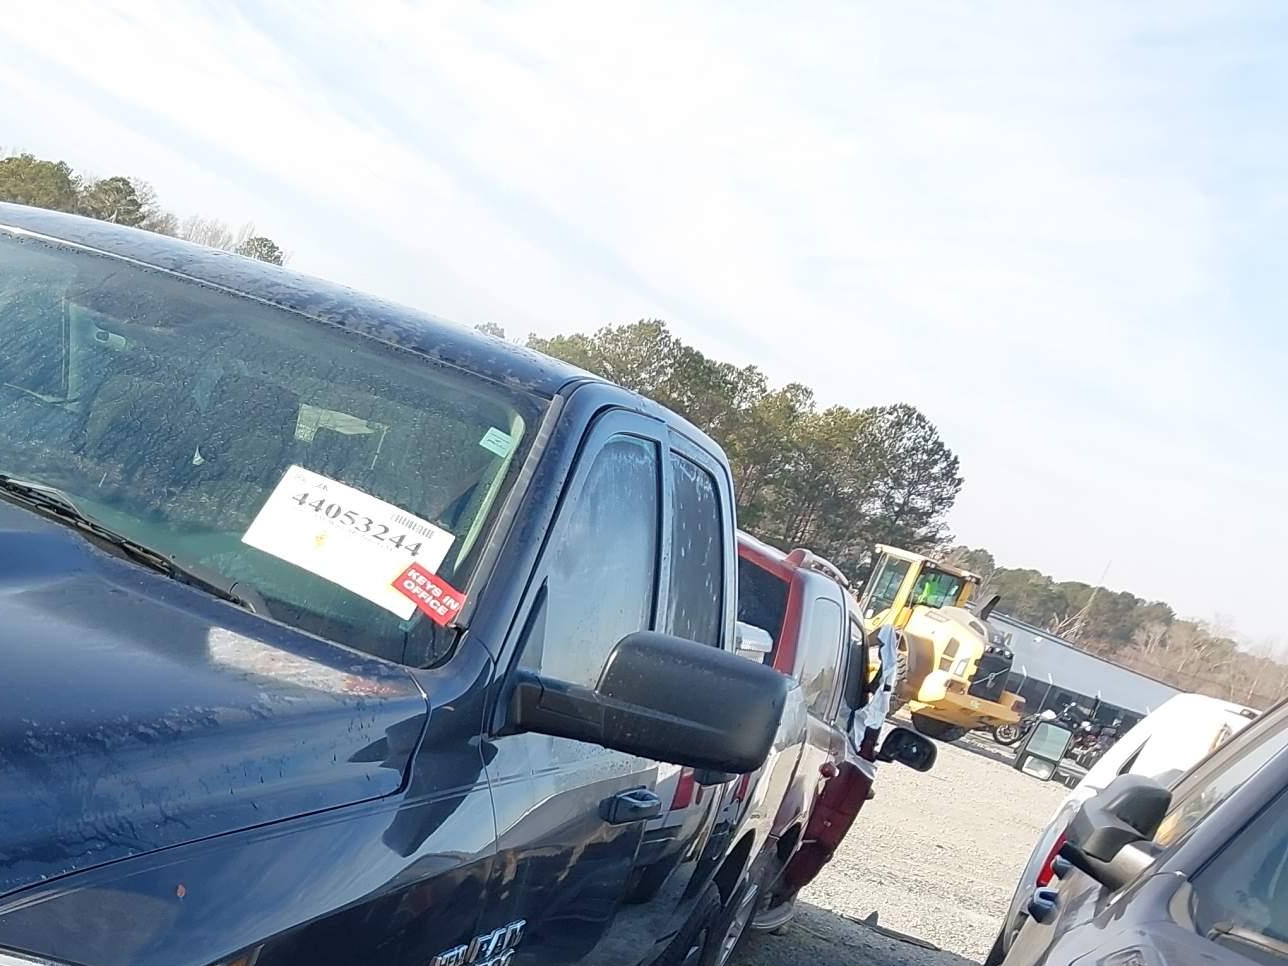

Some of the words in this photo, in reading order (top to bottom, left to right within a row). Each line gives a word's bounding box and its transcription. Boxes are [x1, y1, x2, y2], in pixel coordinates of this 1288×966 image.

[291, 491, 424, 557] 44053244
[403, 580, 449, 616] OFFICE
[407, 569, 443, 598] KEYS
[442, 595, 460, 610] IN
